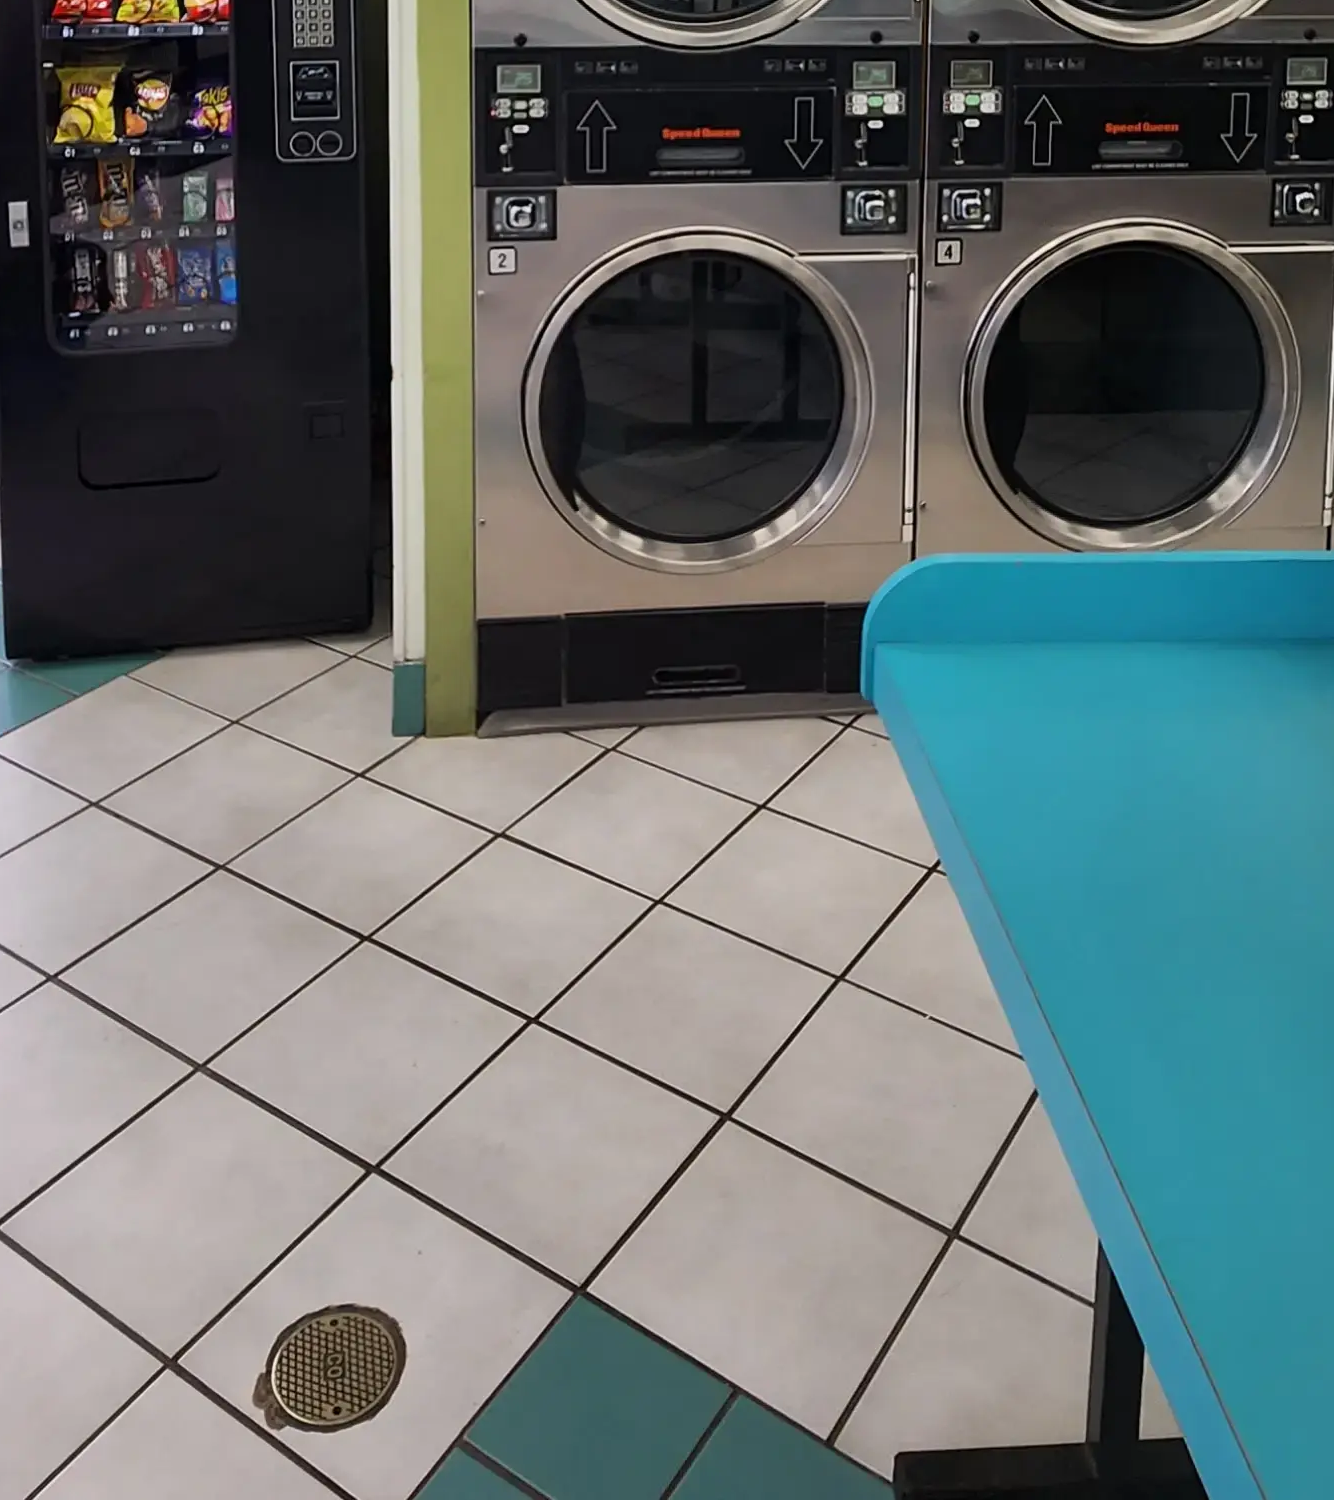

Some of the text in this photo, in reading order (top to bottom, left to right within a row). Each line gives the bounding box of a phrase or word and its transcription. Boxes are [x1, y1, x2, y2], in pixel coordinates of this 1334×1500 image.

[1105, 121, 1179, 134] Speed Queen
[943, 244, 954, 260] 4
[497, 252, 507, 269] 2
